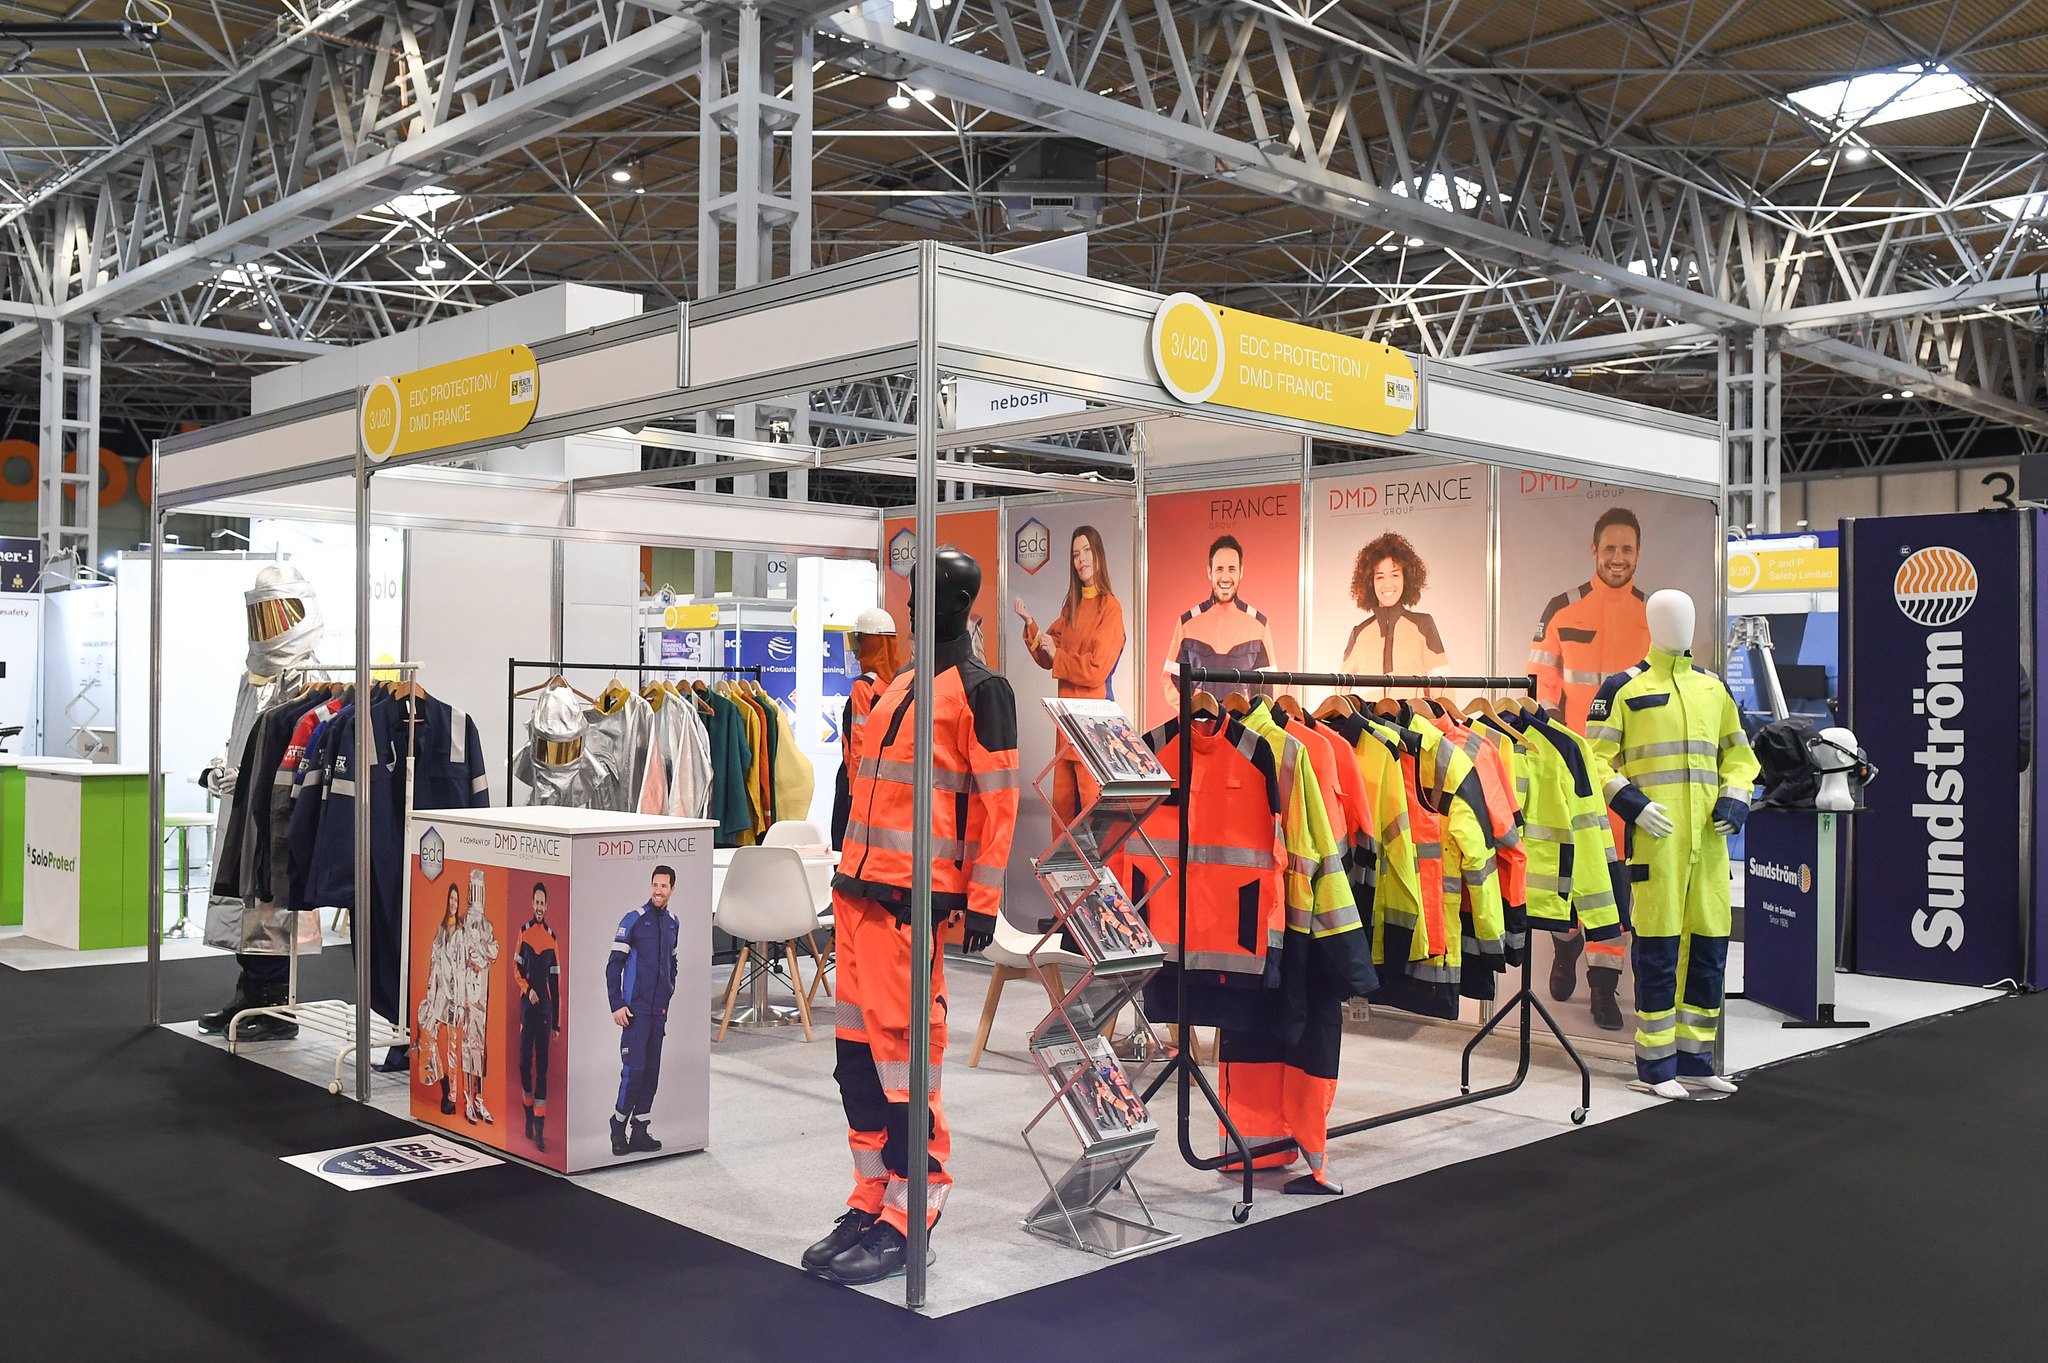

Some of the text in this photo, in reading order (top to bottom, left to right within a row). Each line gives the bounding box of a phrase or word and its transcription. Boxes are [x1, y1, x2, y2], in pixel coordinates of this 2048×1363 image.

[1171, 332, 1208, 363] 3/J20
[1240, 335, 1269, 358] EDC
[1274, 342, 1362, 379] PROTECTION
[409, 388, 428, 408] EDC
[430, 374, 493, 403] PROTECTION
[1240, 365, 1333, 401] DMD FRANCE
[991, 392, 1048, 411] nebosh
[370, 408, 391, 431] 3/J20
[409, 404, 471, 433] DMD FRANCE
[1329, 477, 1473, 511] DMD FRANCE
[1586, 488, 1625, 499] GROUP
[1980, 471, 2016, 508] 3
[1210, 495, 1288, 520] FRANCE
[1382, 506, 1415, 516] GROUP
[1018, 532, 1047, 553] edc
[767, 560, 787, 574] OS
[1768, 559, 1776, 569] P
[1778, 558, 1795, 568] and
[1768, 569, 1833, 581] Safety Limited
[369, 568, 397, 600] olo
[823, 666, 845, 675] aining
[1911, 631, 1965, 952] Sundström
[421, 841, 442, 863] edc
[494, 832, 560, 857] DMD FRANCE
[598, 837, 697, 856] DMD FRANCE
[31, 848, 76, 872] SoloProtect
[1749, 857, 1798, 886] Sundström
